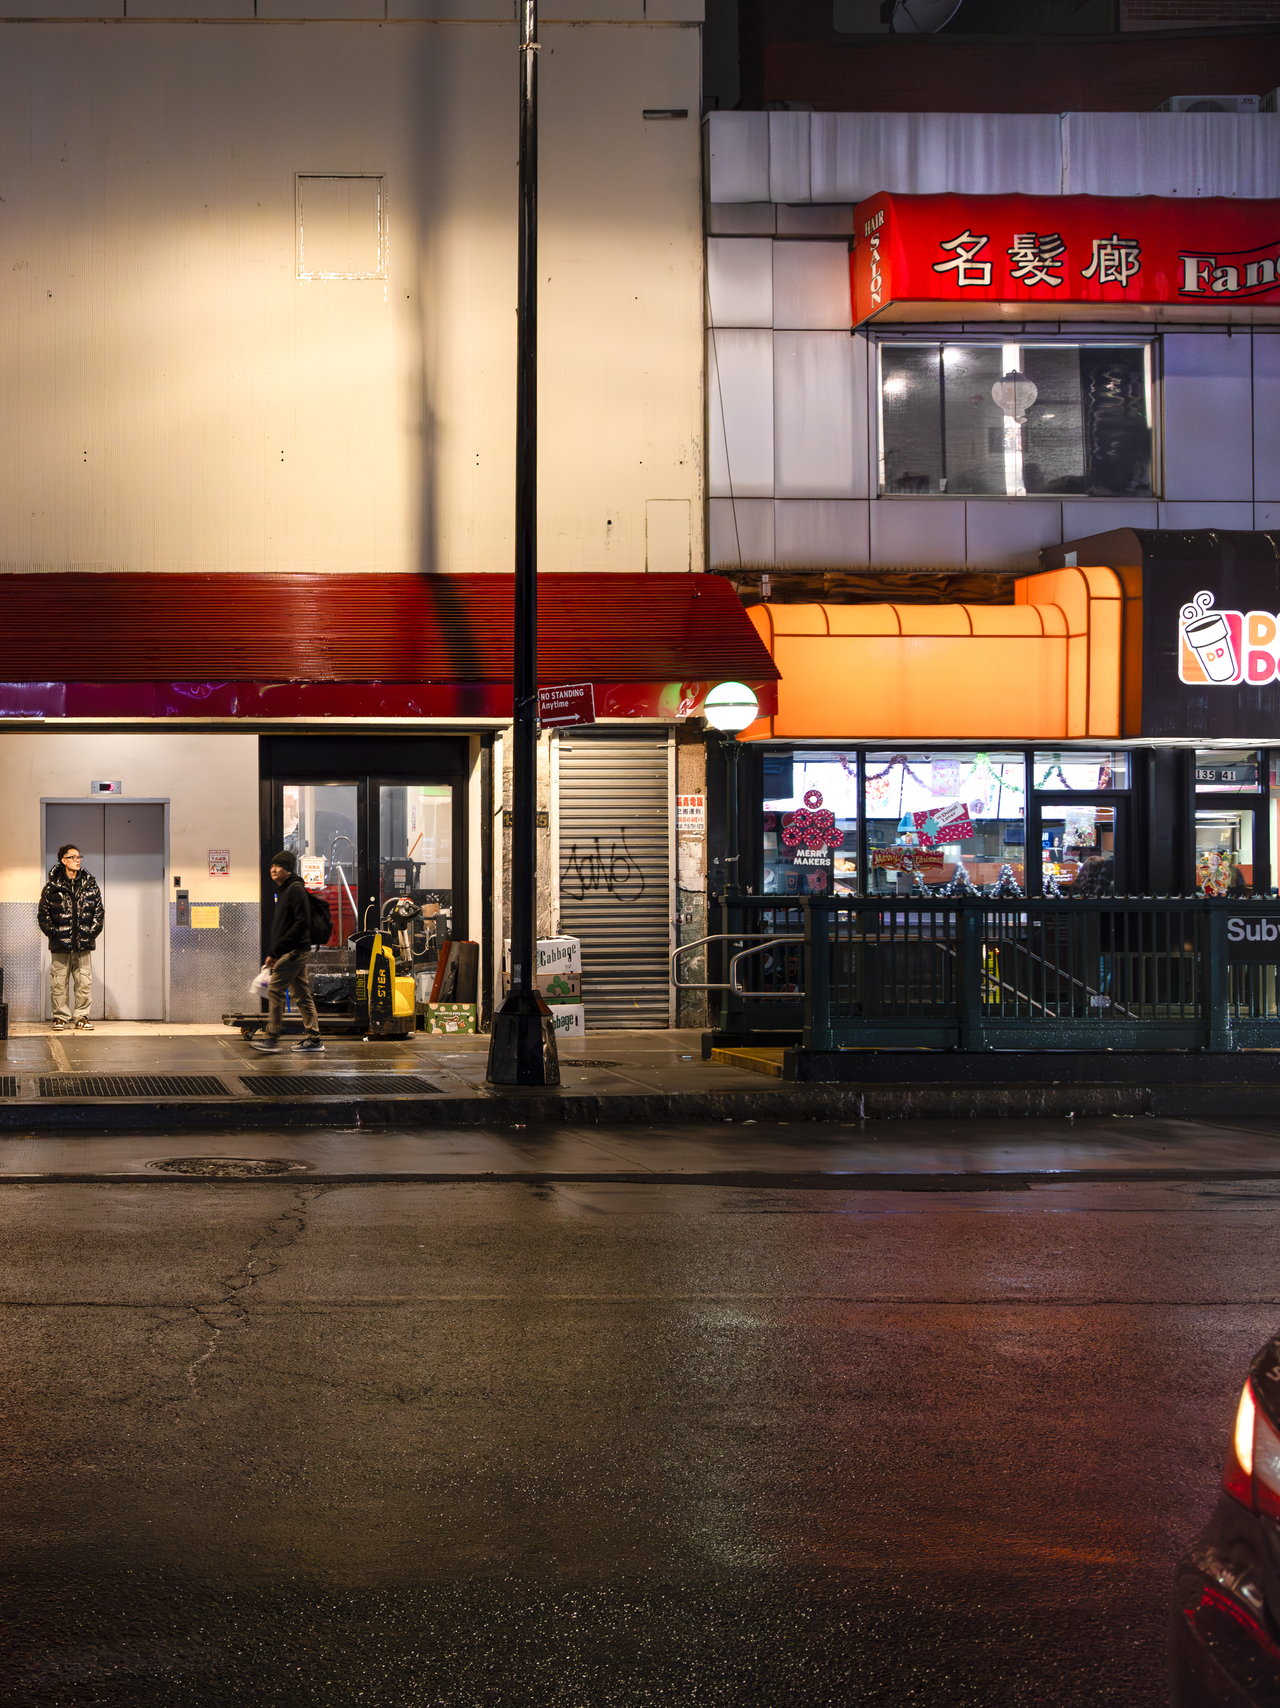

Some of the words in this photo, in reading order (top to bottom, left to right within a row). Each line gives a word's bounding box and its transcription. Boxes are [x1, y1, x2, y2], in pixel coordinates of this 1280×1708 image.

[864, 210, 885, 238] HAIR
[933, 229, 1142, 288] 名髮廊
[869, 232, 883, 309] SALON
[1179, 255, 1280, 292] Fan
[540, 692, 551, 701] NO
[551, 688, 585, 700] STANDING
[541, 700, 569, 711] Anytime
[1196, 770, 1215, 780] 135
[1222, 770, 1236, 780] 41
[941, 805, 958, 817] Donut
[941, 812, 957, 823] Lover
[796, 849, 829, 858] MERRY
[793, 858, 832, 867] MAKERS
[1227, 918, 1280, 942] Sub
[540, 944, 577, 967] Cabbage
